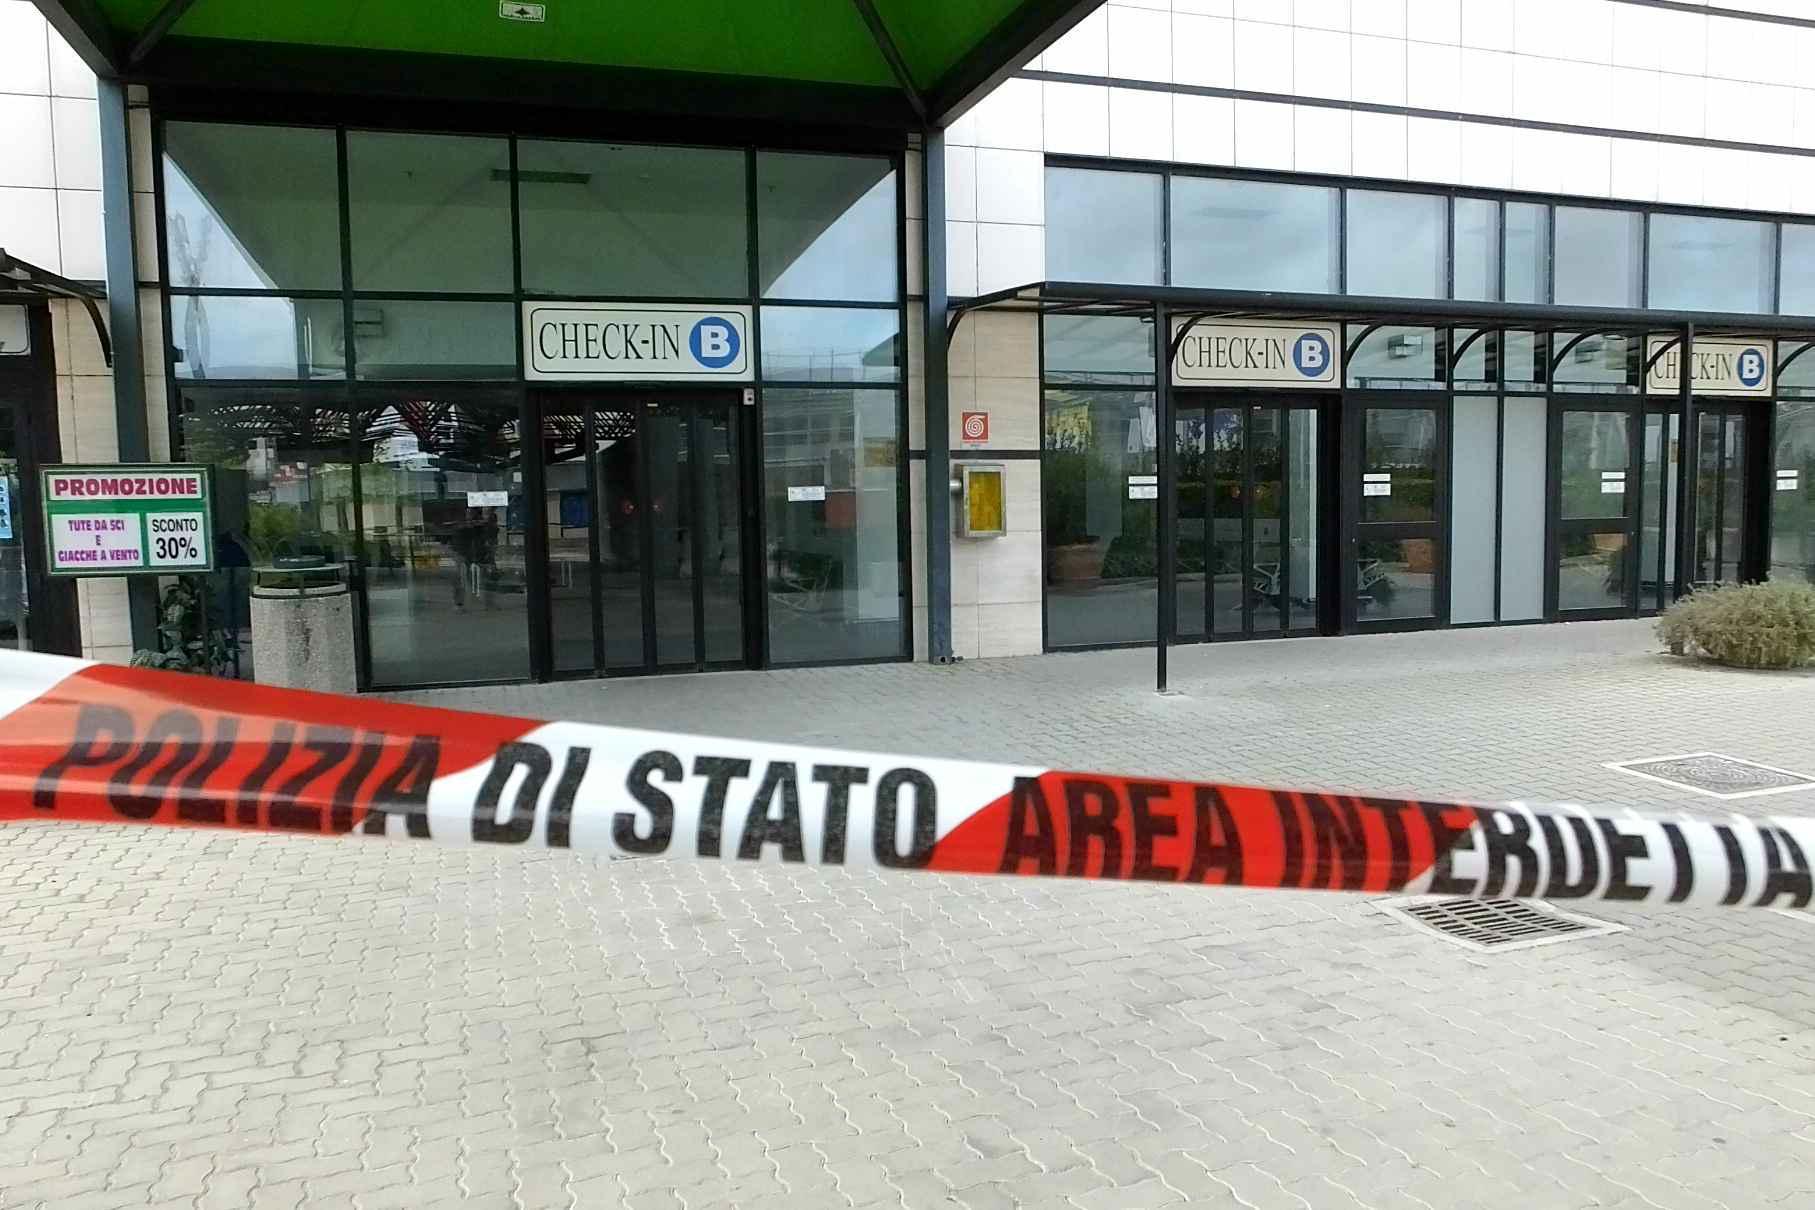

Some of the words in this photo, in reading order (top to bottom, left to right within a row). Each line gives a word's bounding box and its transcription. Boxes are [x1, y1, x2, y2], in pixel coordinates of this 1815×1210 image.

[539, 322, 681, 360] CHECK-IN
[700, 324, 731, 358] B
[1182, 335, 1286, 369] CHECK-IN
[1301, 339, 1323, 368] B
[1655, 351, 1732, 381] CHCK-IN
[1742, 354, 1760, 379] B
[54, 478, 198, 496] PROMOZIONE
[68, 519, 92, 531] TUTE
[94, 519, 108, 531] DA
[110, 519, 125, 531] SCI
[152, 518, 198, 533] SCONTO
[95, 535, 102, 546] E
[156, 537, 198, 559] 30%
[58, 549, 98, 562] GIACCHE
[101, 549, 107, 560] A
[110, 548, 139, 560] VENTO
[32, 704, 442, 840] POLIZIA
[471, 741, 592, 850] DI
[612, 749, 937, 870] STATO
[1000, 776, 1244, 886] AREA
